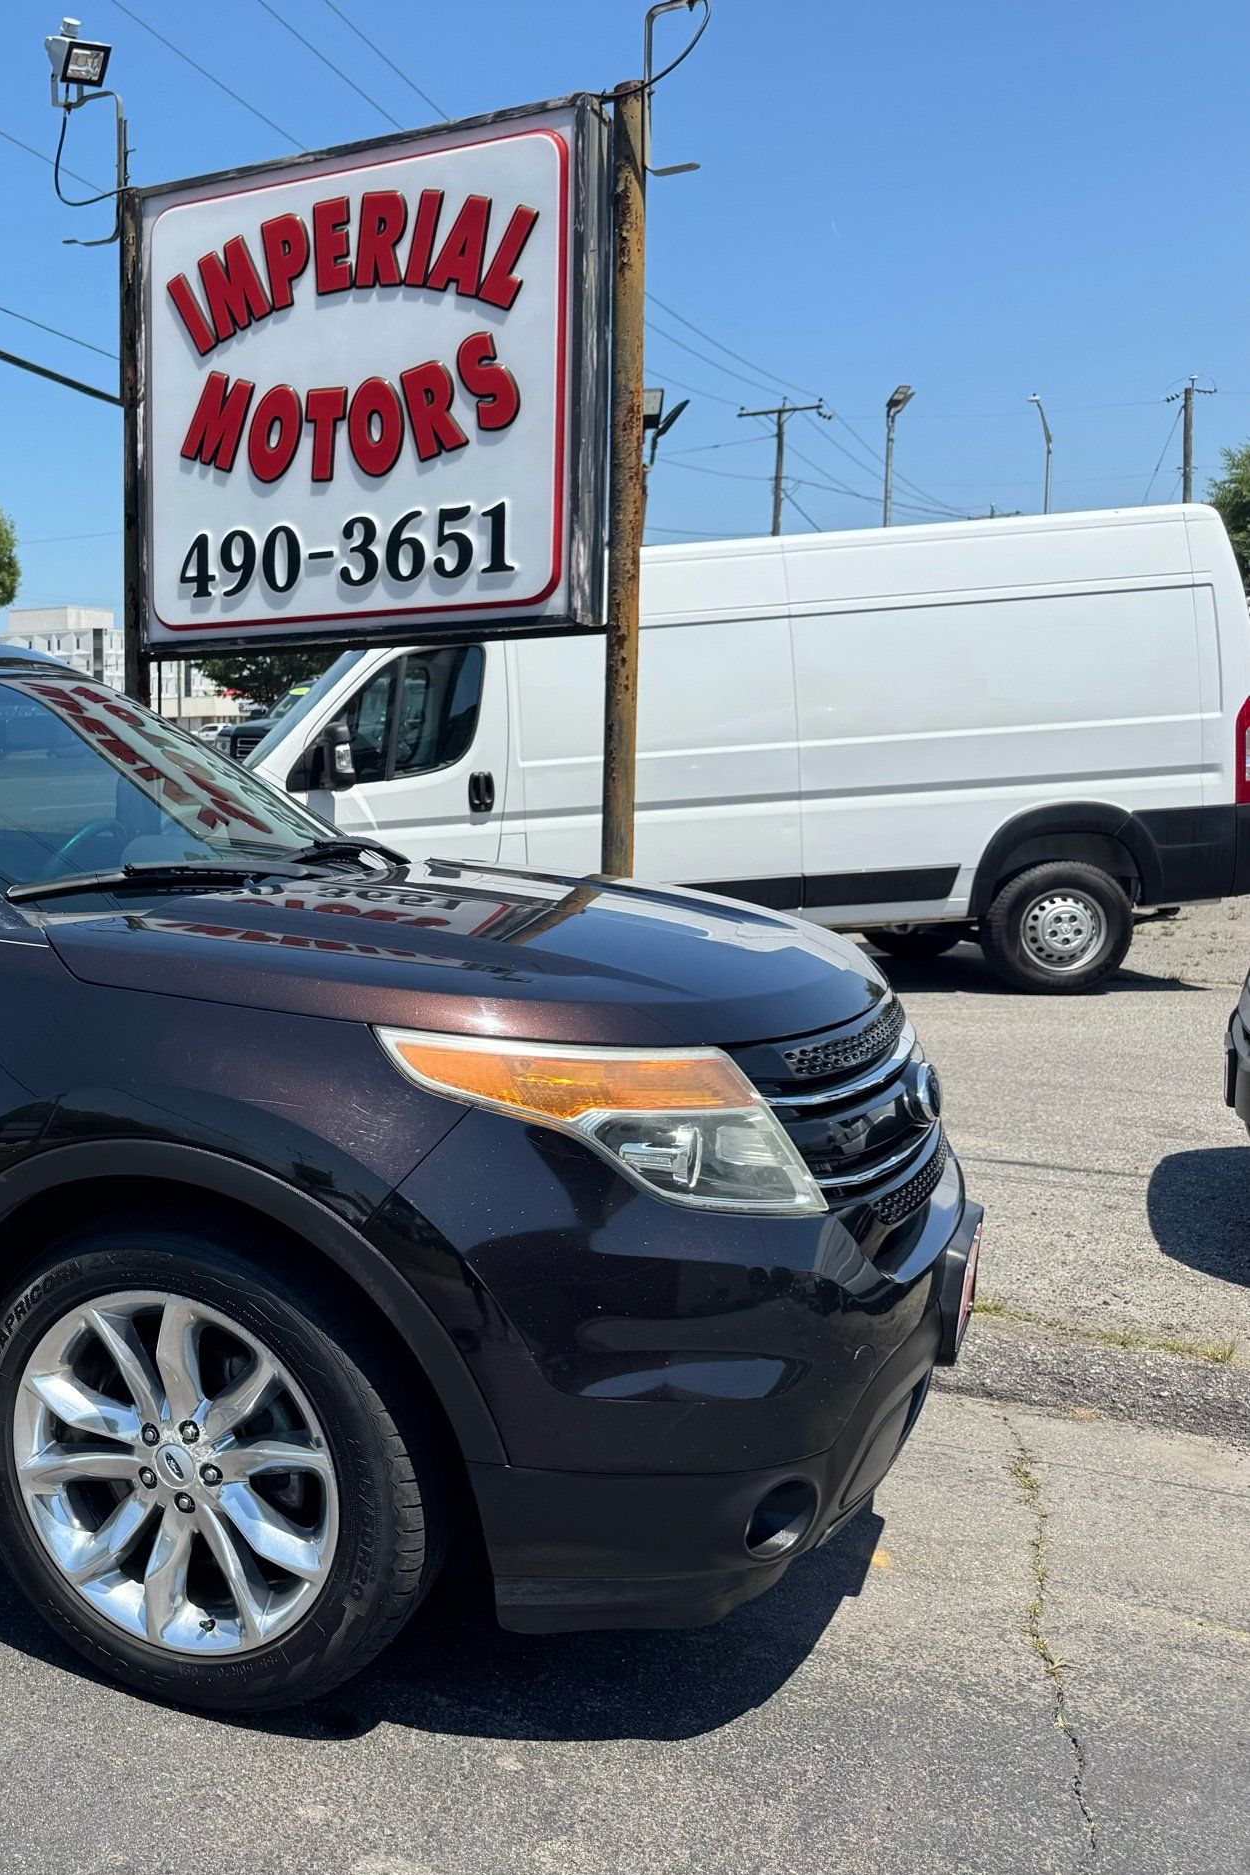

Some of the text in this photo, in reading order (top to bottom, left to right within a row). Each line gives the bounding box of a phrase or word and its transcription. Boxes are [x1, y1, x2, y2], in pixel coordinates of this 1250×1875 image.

[166, 188, 539, 356] IMPERIAL
[180, 331, 521, 483] MOTORS
[179, 501, 515, 599] 490-3651
